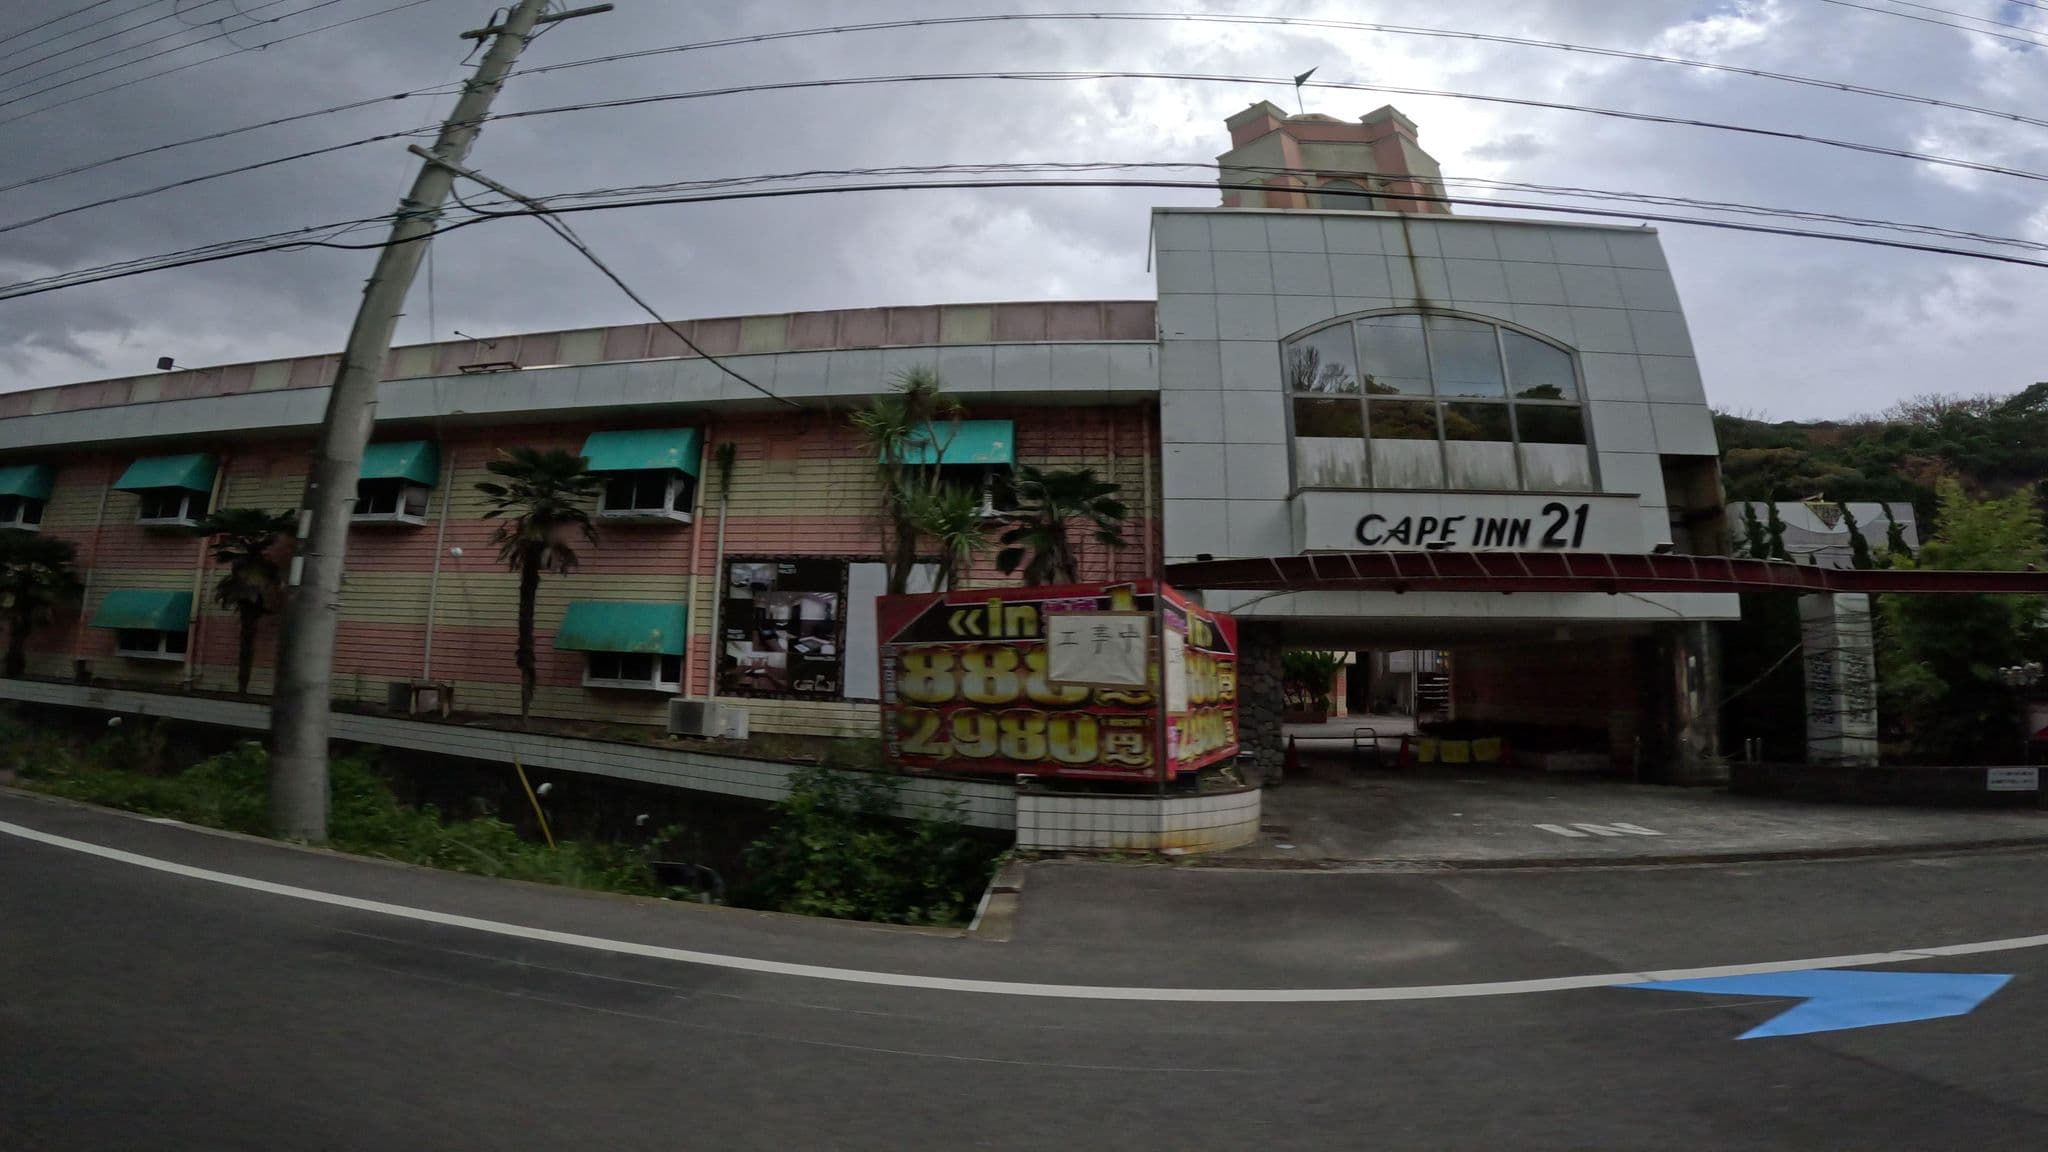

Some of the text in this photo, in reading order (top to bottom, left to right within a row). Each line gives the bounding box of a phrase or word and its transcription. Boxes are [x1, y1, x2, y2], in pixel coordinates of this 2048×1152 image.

[1356, 502, 1590, 549] CAPE INN 21
